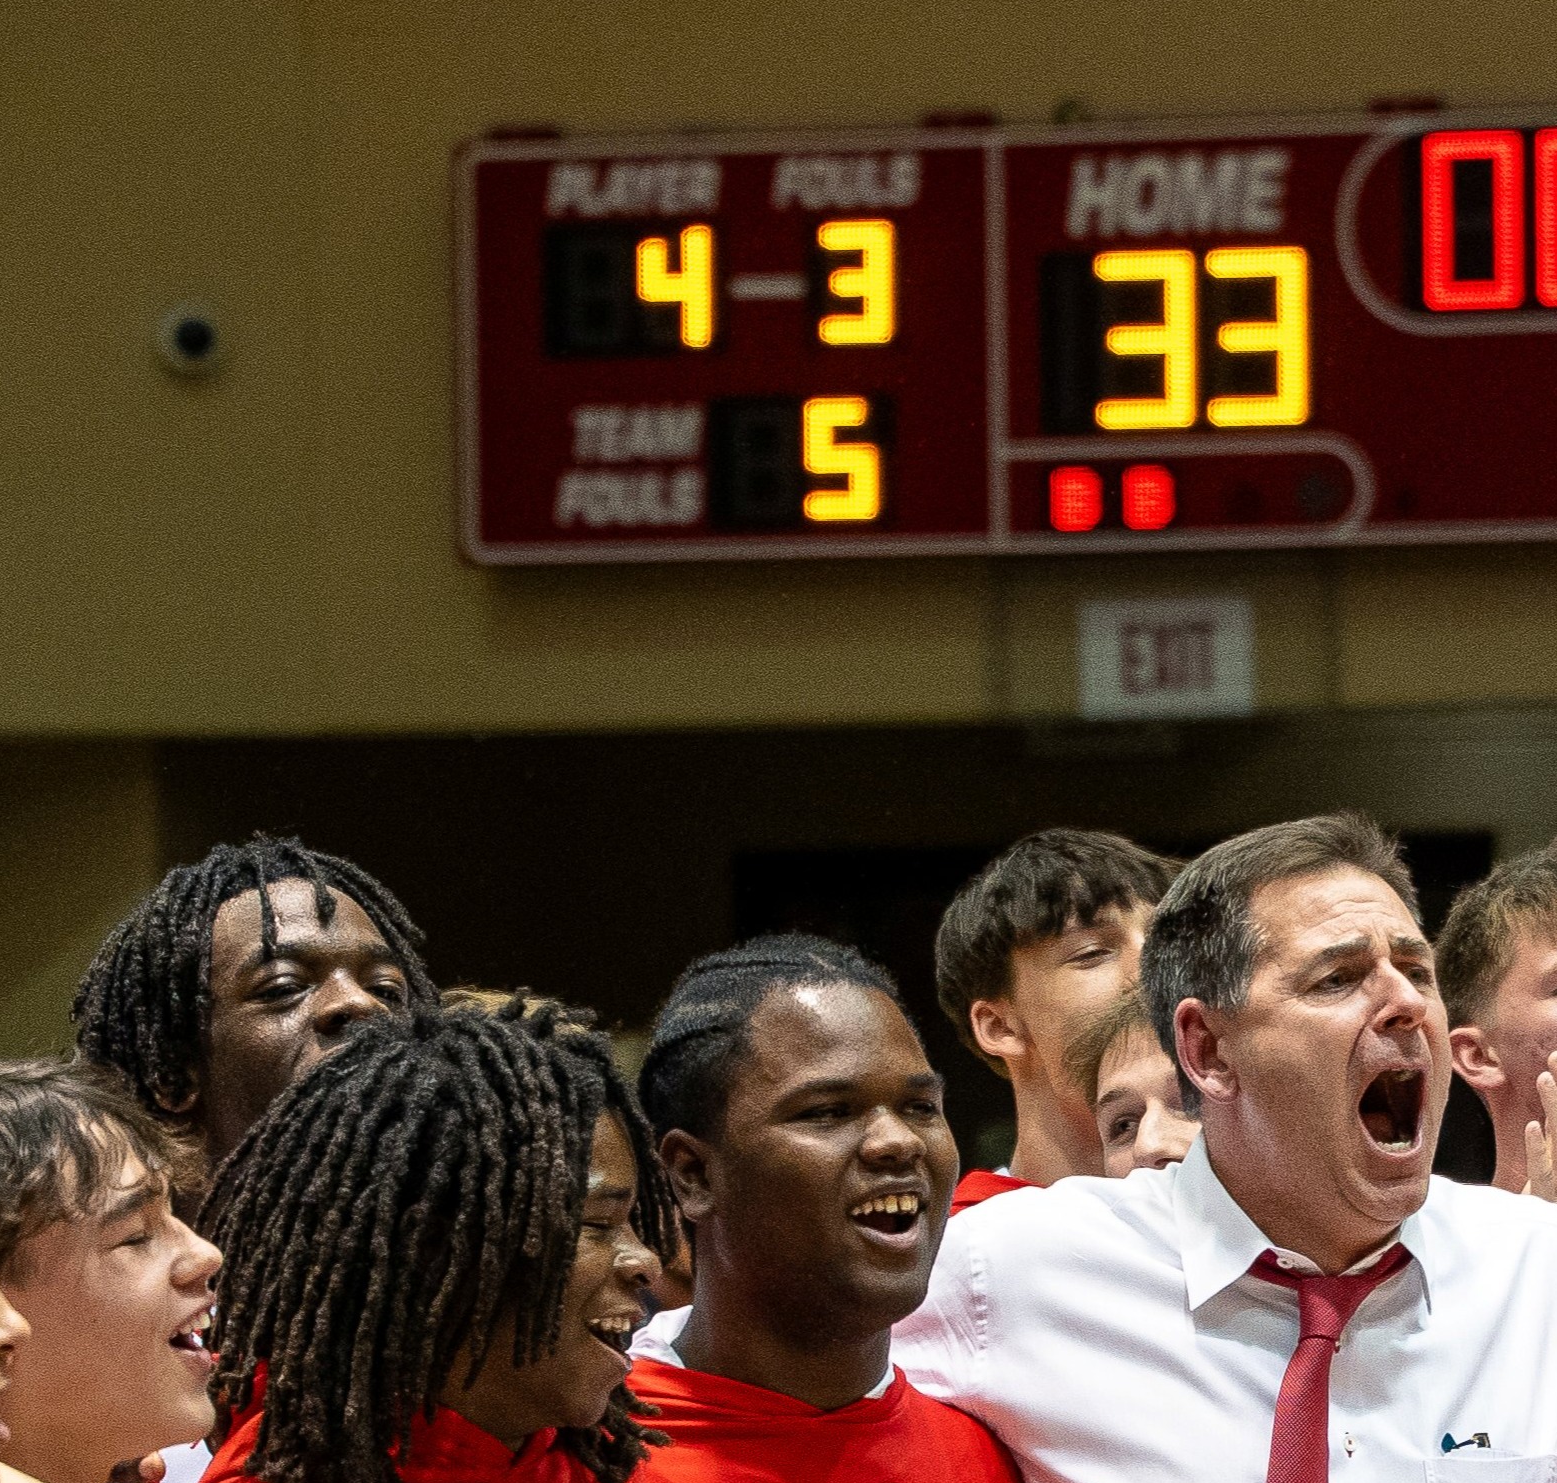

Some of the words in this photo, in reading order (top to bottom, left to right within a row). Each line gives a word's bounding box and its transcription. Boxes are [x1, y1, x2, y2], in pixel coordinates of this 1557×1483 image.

[548, 157, 722, 217] PLAYER
[772, 153, 922, 210] FOULS
[1067, 150, 1289, 240] HOME
[637, 226, 712, 347] 4
[819, 221, 893, 345] 3
[1095, 247, 1308, 429] 33
[571, 405, 706, 463] TEAM
[804, 398, 879, 521] 5
[554, 468, 706, 526] FOULS
[1119, 620, 1218, 695] EXIT
